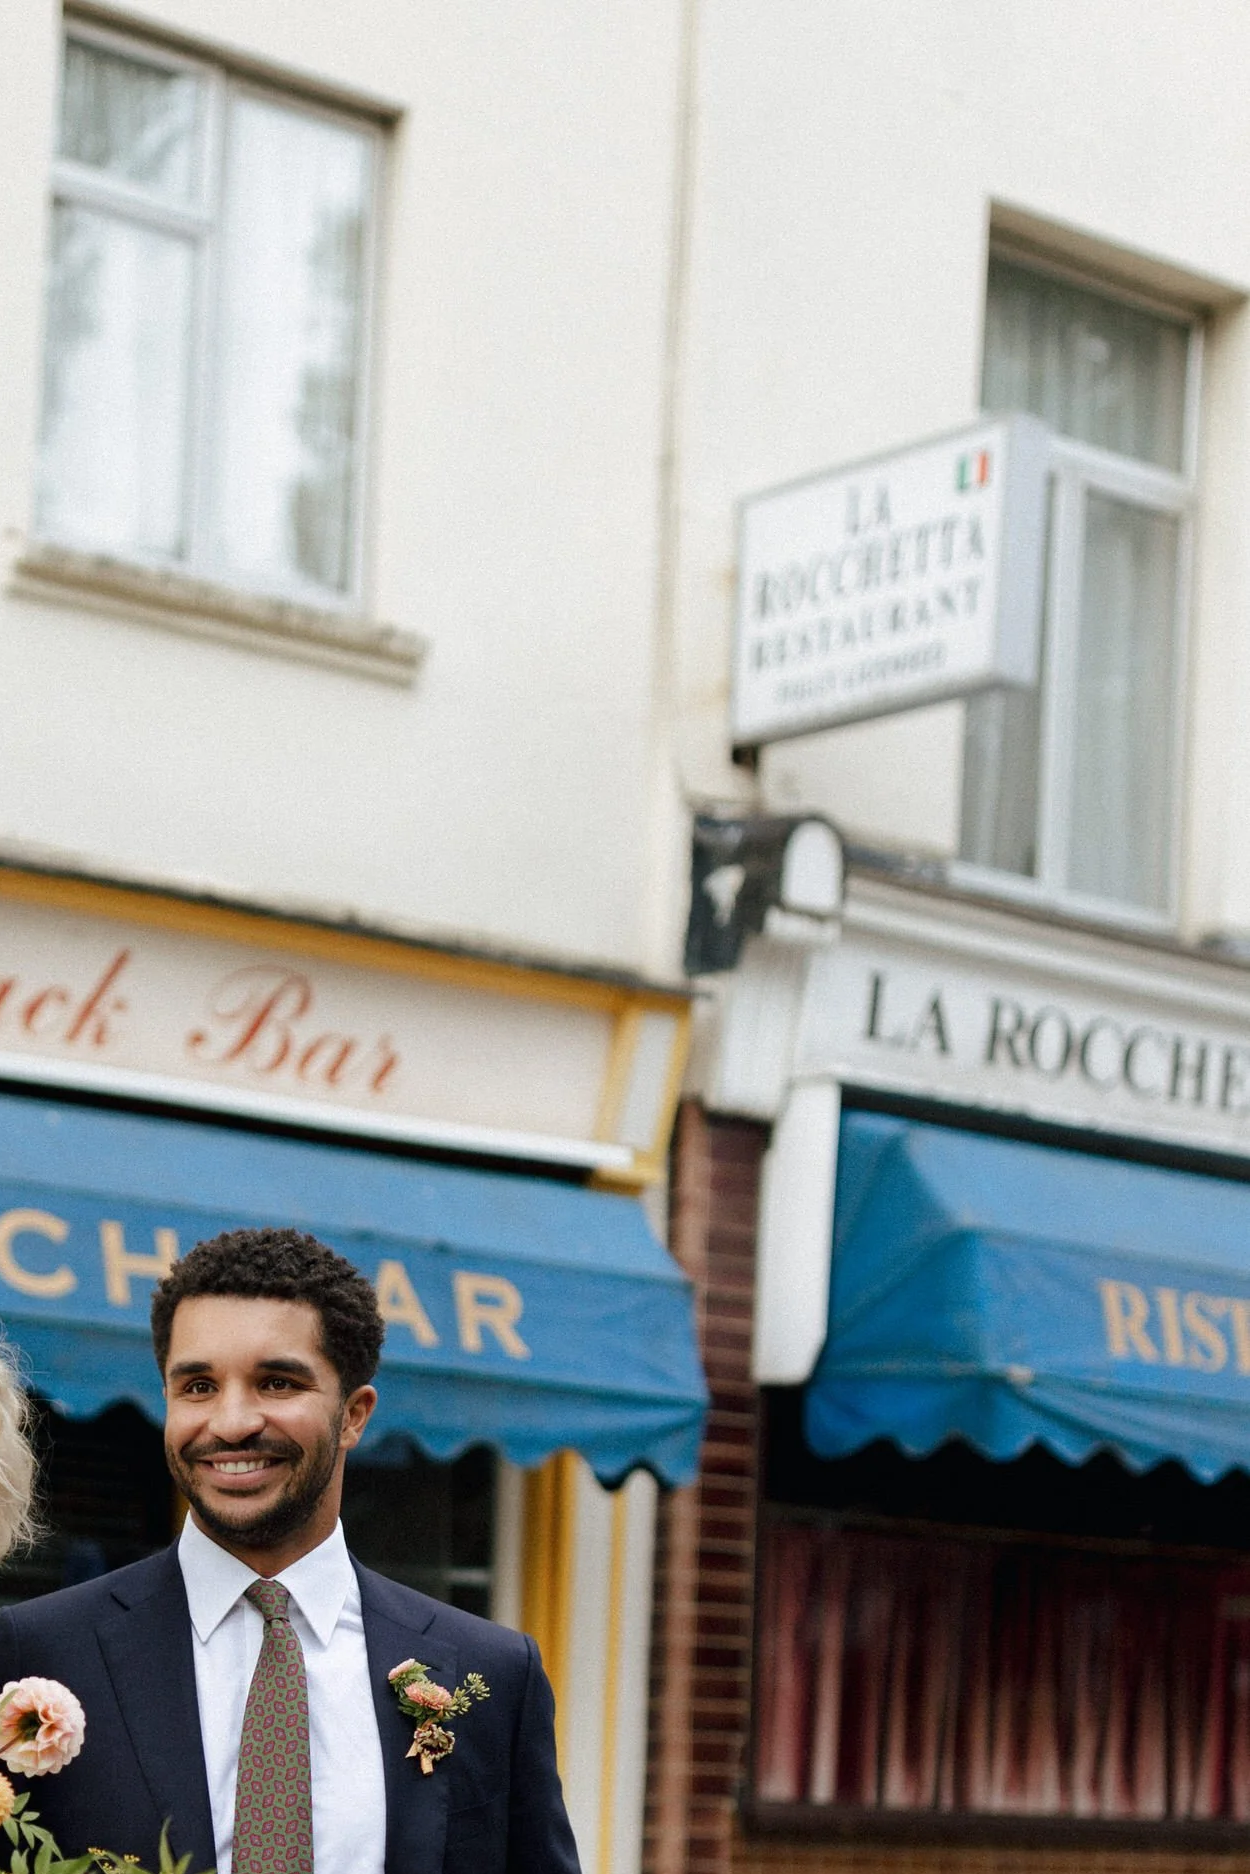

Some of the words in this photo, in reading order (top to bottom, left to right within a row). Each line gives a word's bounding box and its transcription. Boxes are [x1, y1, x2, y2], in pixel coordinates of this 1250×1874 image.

[846, 480, 892, 536] LA
[753, 513, 985, 619] ROCCHETTA
[749, 576, 982, 671] RESTAURANT
[188, 962, 403, 1095] Bar
[866, 970, 951, 1055] LA
[376, 1258, 531, 1359] AR
